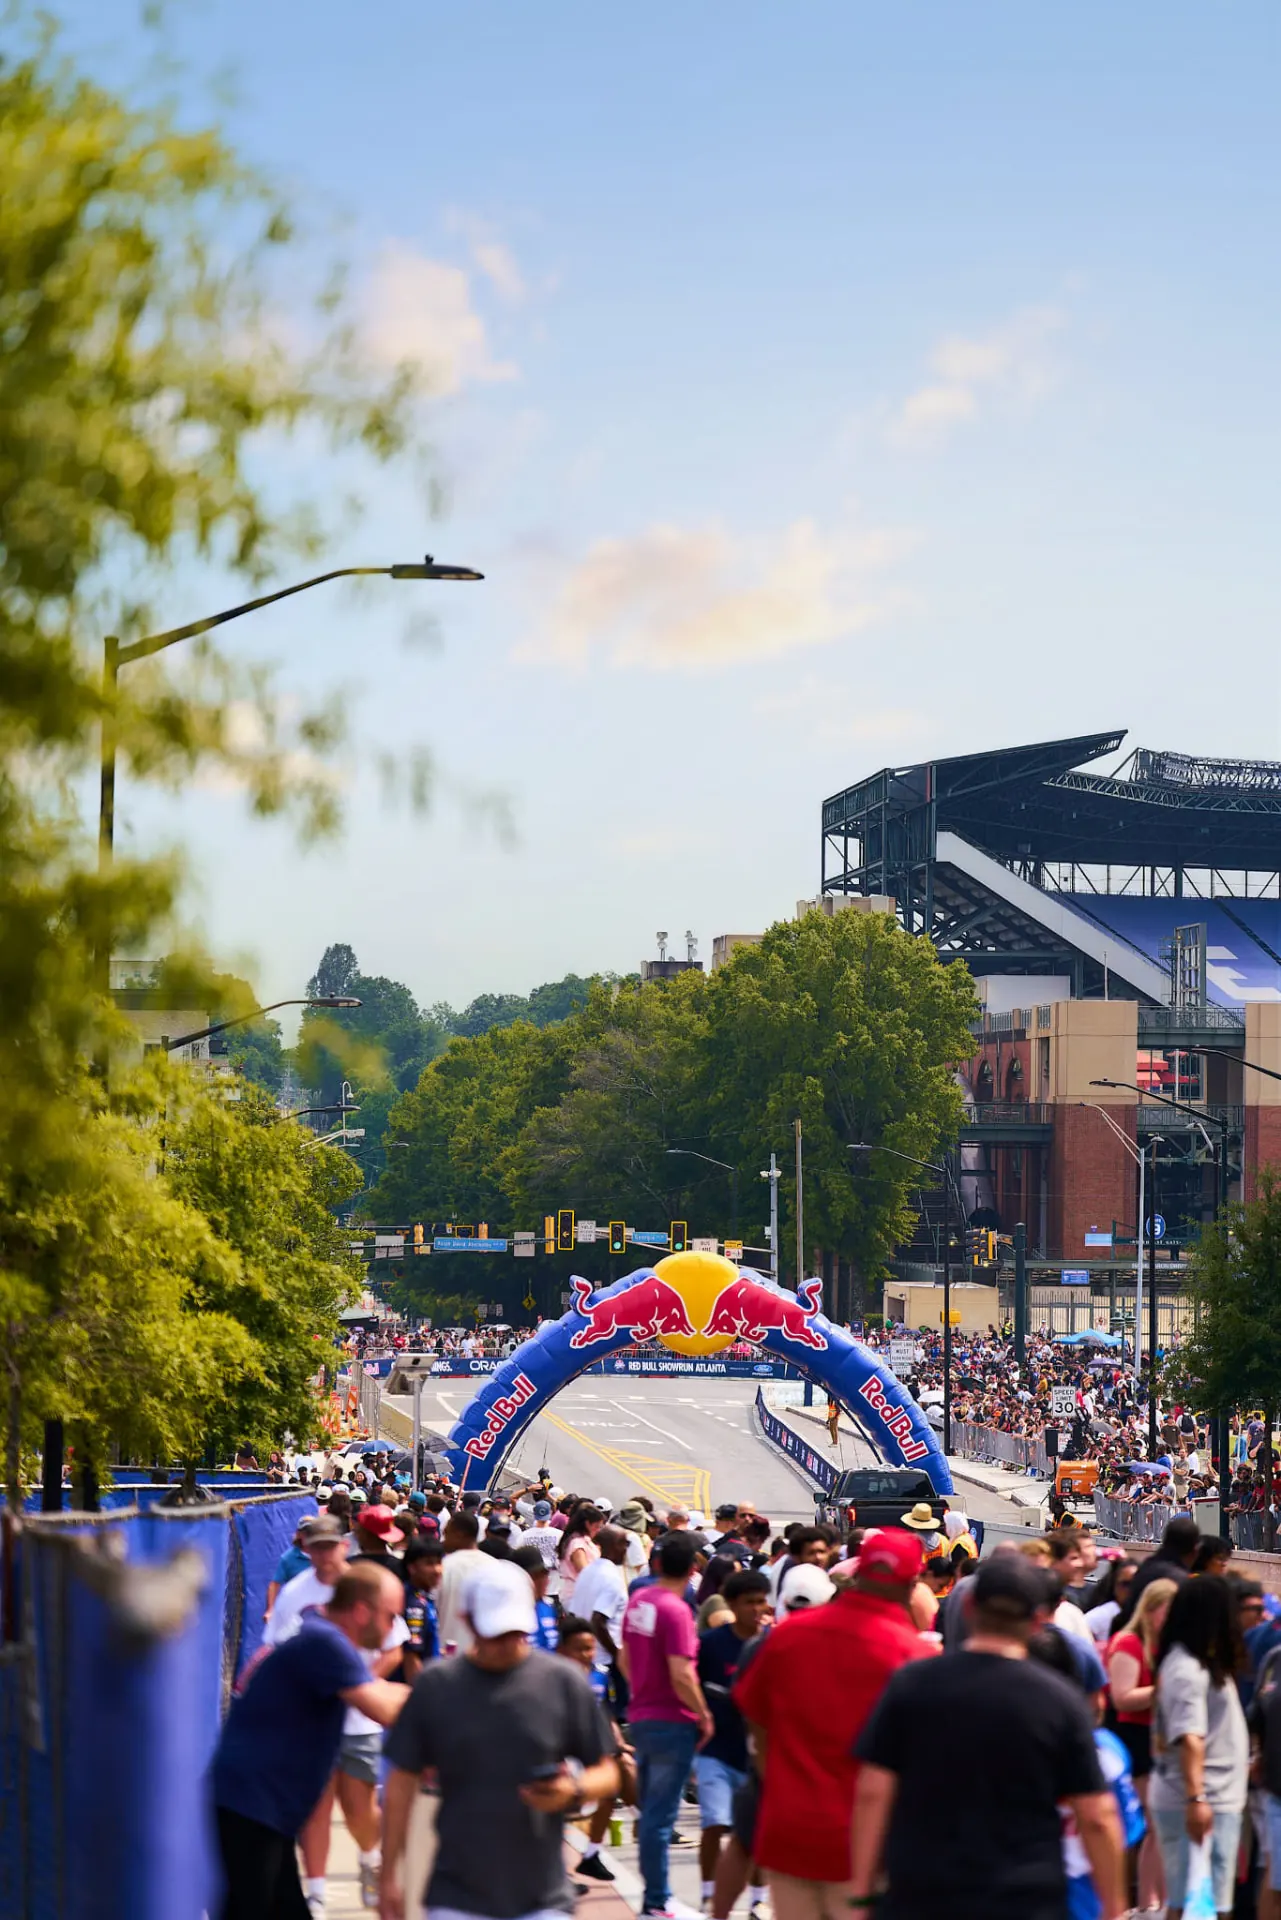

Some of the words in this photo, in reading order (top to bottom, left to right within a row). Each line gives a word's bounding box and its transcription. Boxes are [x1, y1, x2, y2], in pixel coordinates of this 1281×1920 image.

[431, 1360, 453, 1372] INGS.
[469, 1360, 503, 1372] ORA
[628, 1361, 642, 1371] RED
[642, 1361, 658, 1372] BULL
[658, 1362, 694, 1373] SHOWRUN
[695, 1363, 727, 1374] ATLANTA
[1054, 1402, 1074, 1414] 30
[458, 1409, 508, 1461] Red
[491, 1372, 538, 1422] Bull
[858, 1374, 905, 1425] Red
[886, 1412, 930, 1463] Bull
